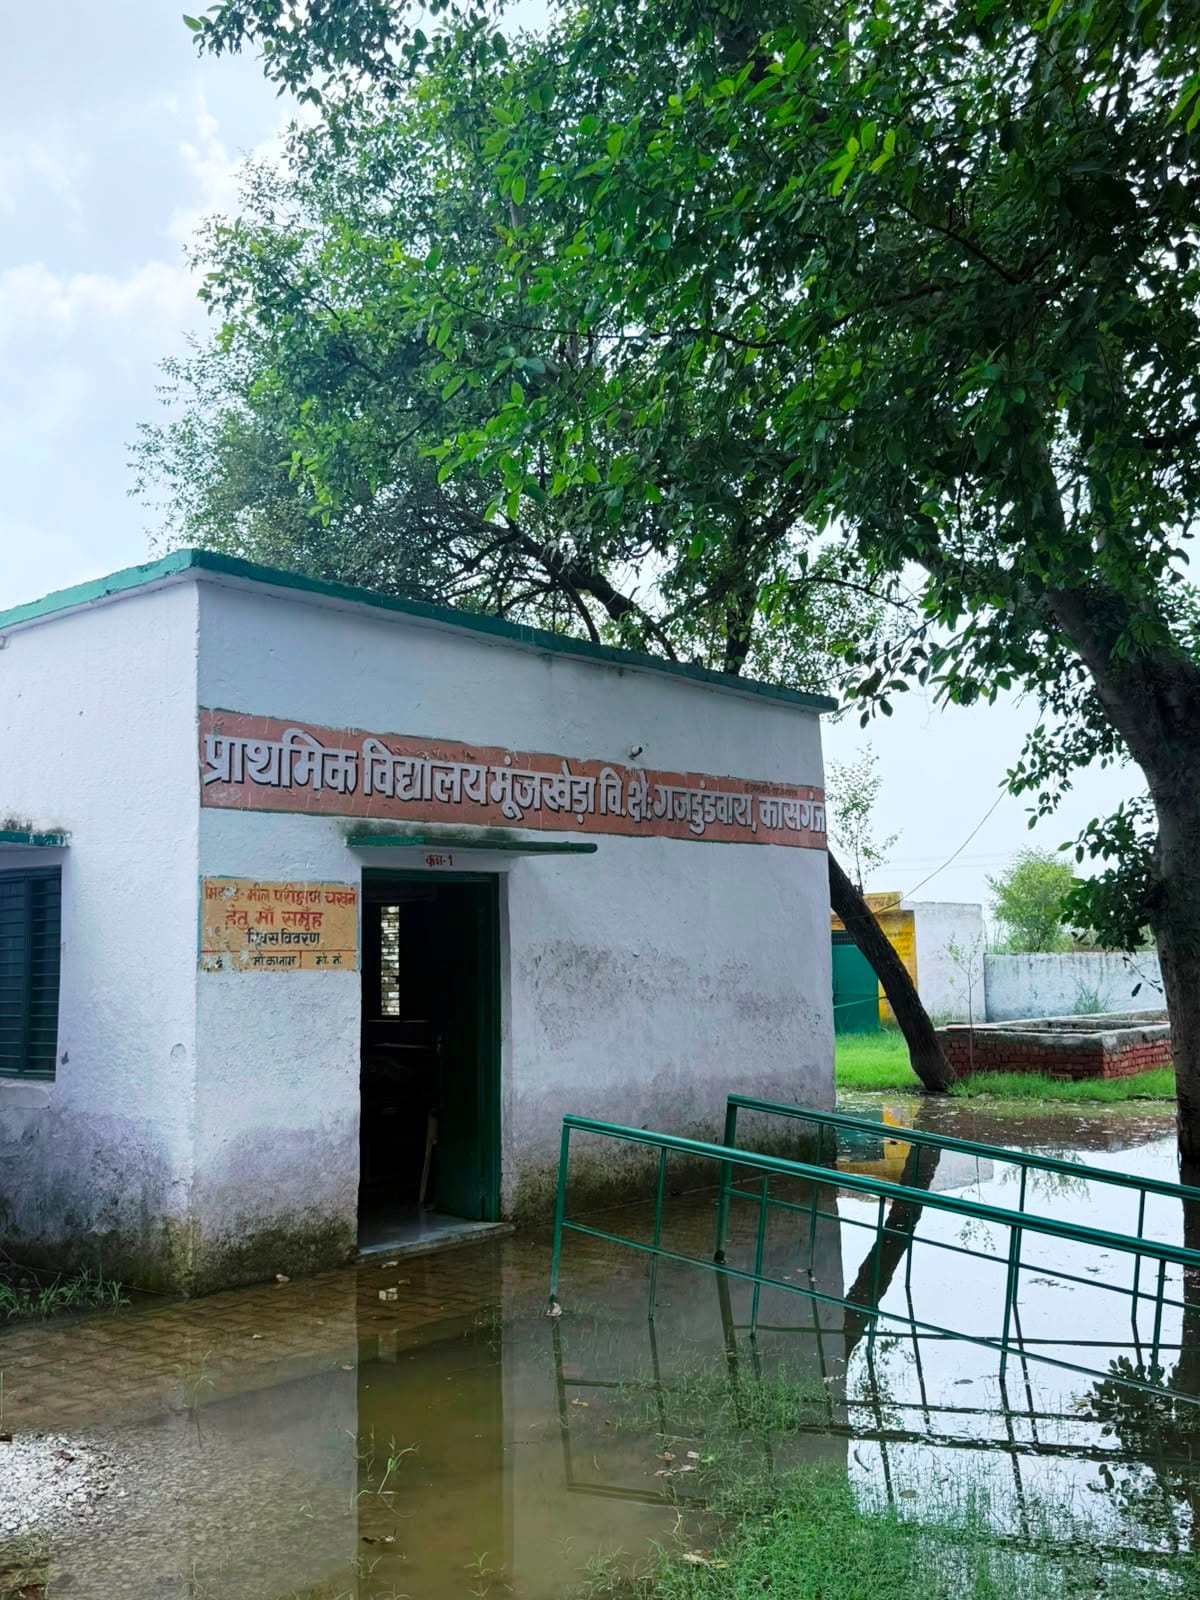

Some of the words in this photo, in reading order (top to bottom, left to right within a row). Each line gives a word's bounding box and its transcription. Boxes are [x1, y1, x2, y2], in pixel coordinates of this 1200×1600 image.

[204, 727, 358, 796] प्राथमिक
[363, 738, 489, 805] विद्यालय
[281, 928, 321, 946] विवरण
